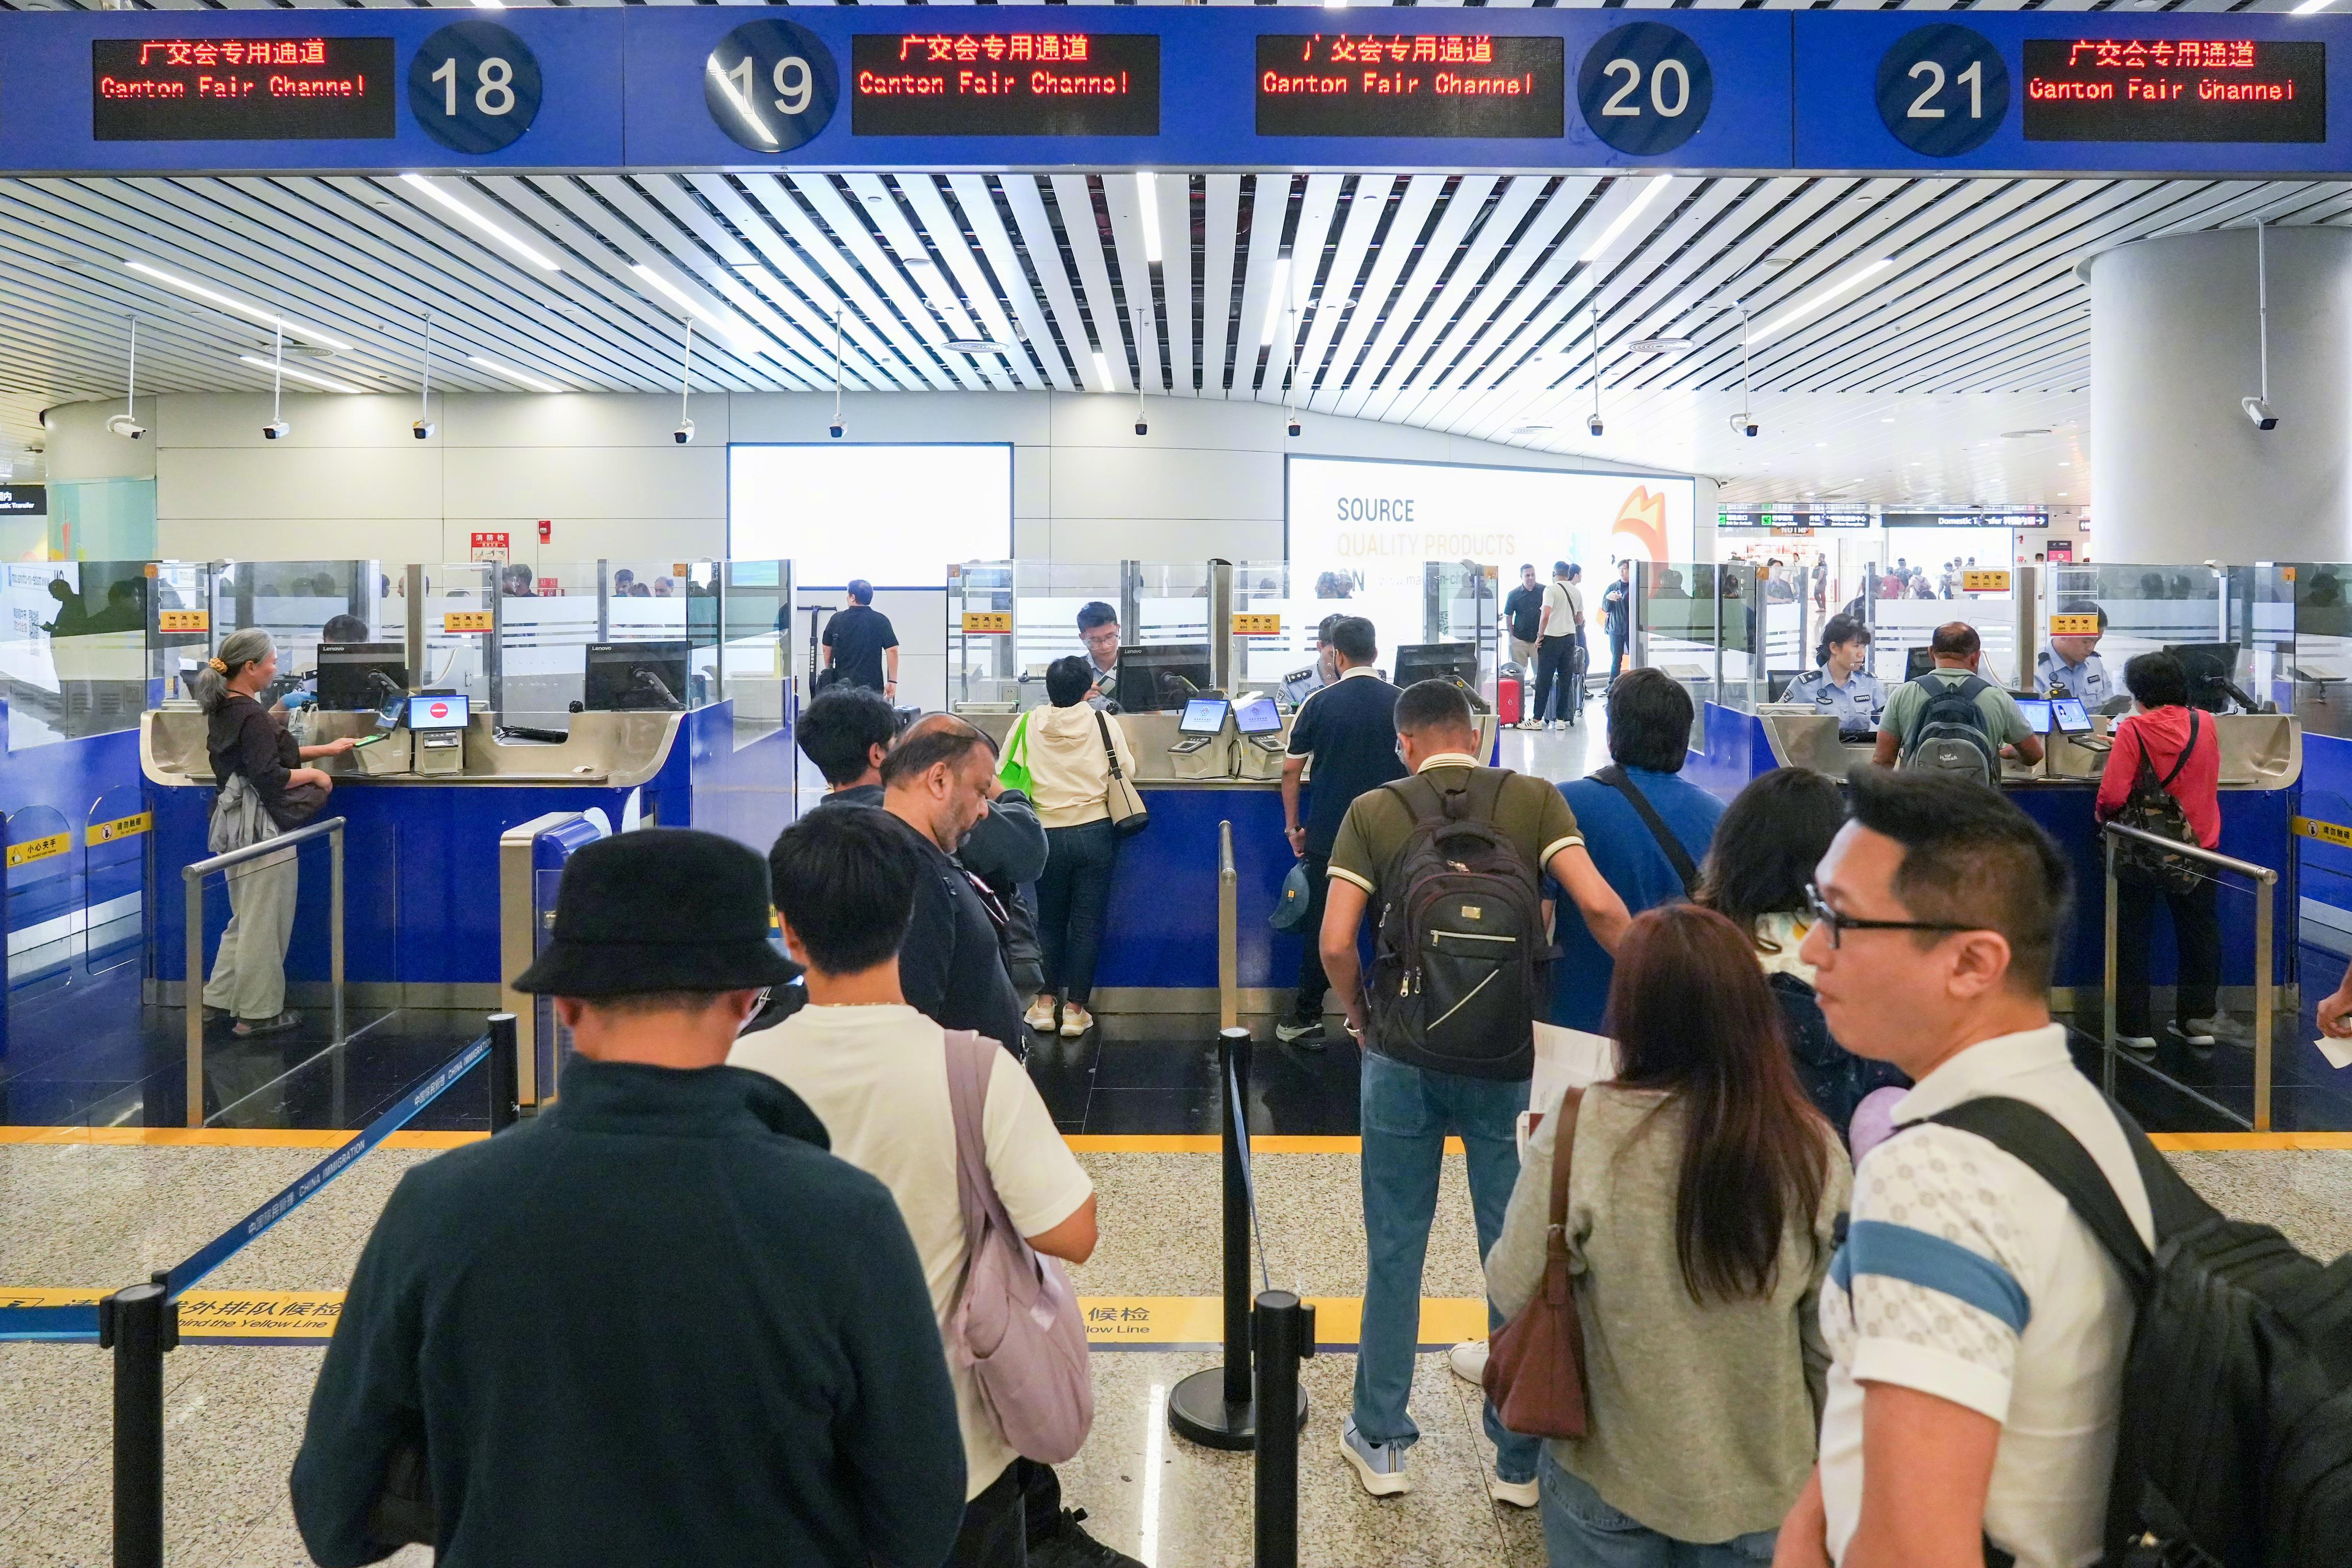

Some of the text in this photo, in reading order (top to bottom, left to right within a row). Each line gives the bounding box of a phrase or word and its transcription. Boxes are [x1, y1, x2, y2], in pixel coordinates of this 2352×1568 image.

[140, 39, 326, 66] 广交会专用通道
[900, 34, 1089, 61] 广交会专用通道
[2069, 40, 2254, 66] 广交会专用通道
[101, 76, 184, 98] Canton
[200, 76, 255, 97] Fair
[432, 57, 515, 116] 18
[729, 56, 813, 115] 19
[860, 70, 945, 94] Canton
[960, 70, 1015, 94] Fair
[1263, 71, 1531, 94] Canton Fair Channel
[1602, 58, 1690, 117] 20
[1906, 61, 1982, 118] 21
[2029, 78, 2113, 99] Canton
[2128, 78, 2184, 99] Fair
[1337, 497, 1414, 522] SOURCE
[1337, 533, 1515, 556] QUALITY PRODUCTS
[117, 817, 141, 830] 请勿触碰
[2323, 826, 2350, 839] 请勿触碰
[28, 839, 56, 853] 小心夹手
[448, 1061, 463, 1080] CHINA
[299, 1139, 365, 1197] CHINA IMMIGRATION
[248, 1191, 295, 1236] 中国移民管理
[212, 1319, 236, 1327] the
[241, 1319, 292, 1328] Yellow
[293, 1319, 328, 1328] Line
[1088, 1307, 1150, 1321] 候检
